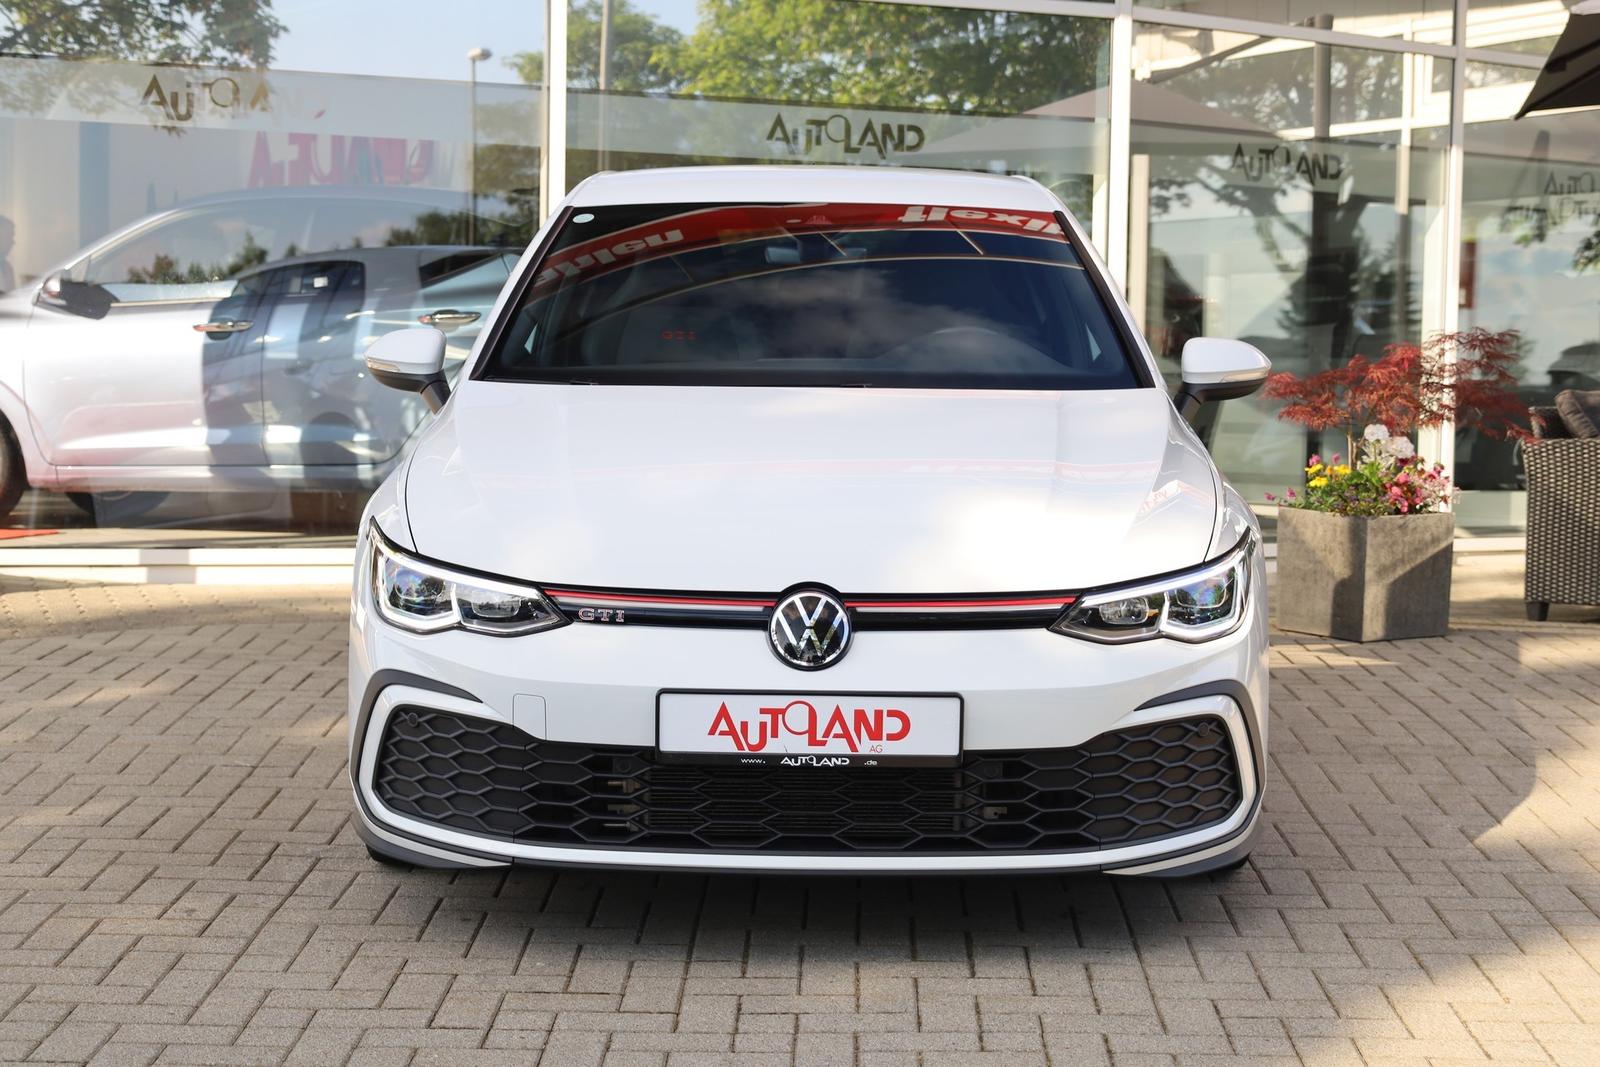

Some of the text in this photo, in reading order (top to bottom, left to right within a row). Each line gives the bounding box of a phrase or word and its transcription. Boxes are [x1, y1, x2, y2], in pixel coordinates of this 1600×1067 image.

[766, 112, 925, 159] AUTOLAND
[1231, 143, 1343, 186] AUTOAND
[1543, 170, 1598, 195] AUTO
[578, 607, 625, 622] GTI
[708, 700, 911, 752] AUTOLAND
[780, 755, 850, 767] AUTOLAND
[869, 744, 884, 754] AG
